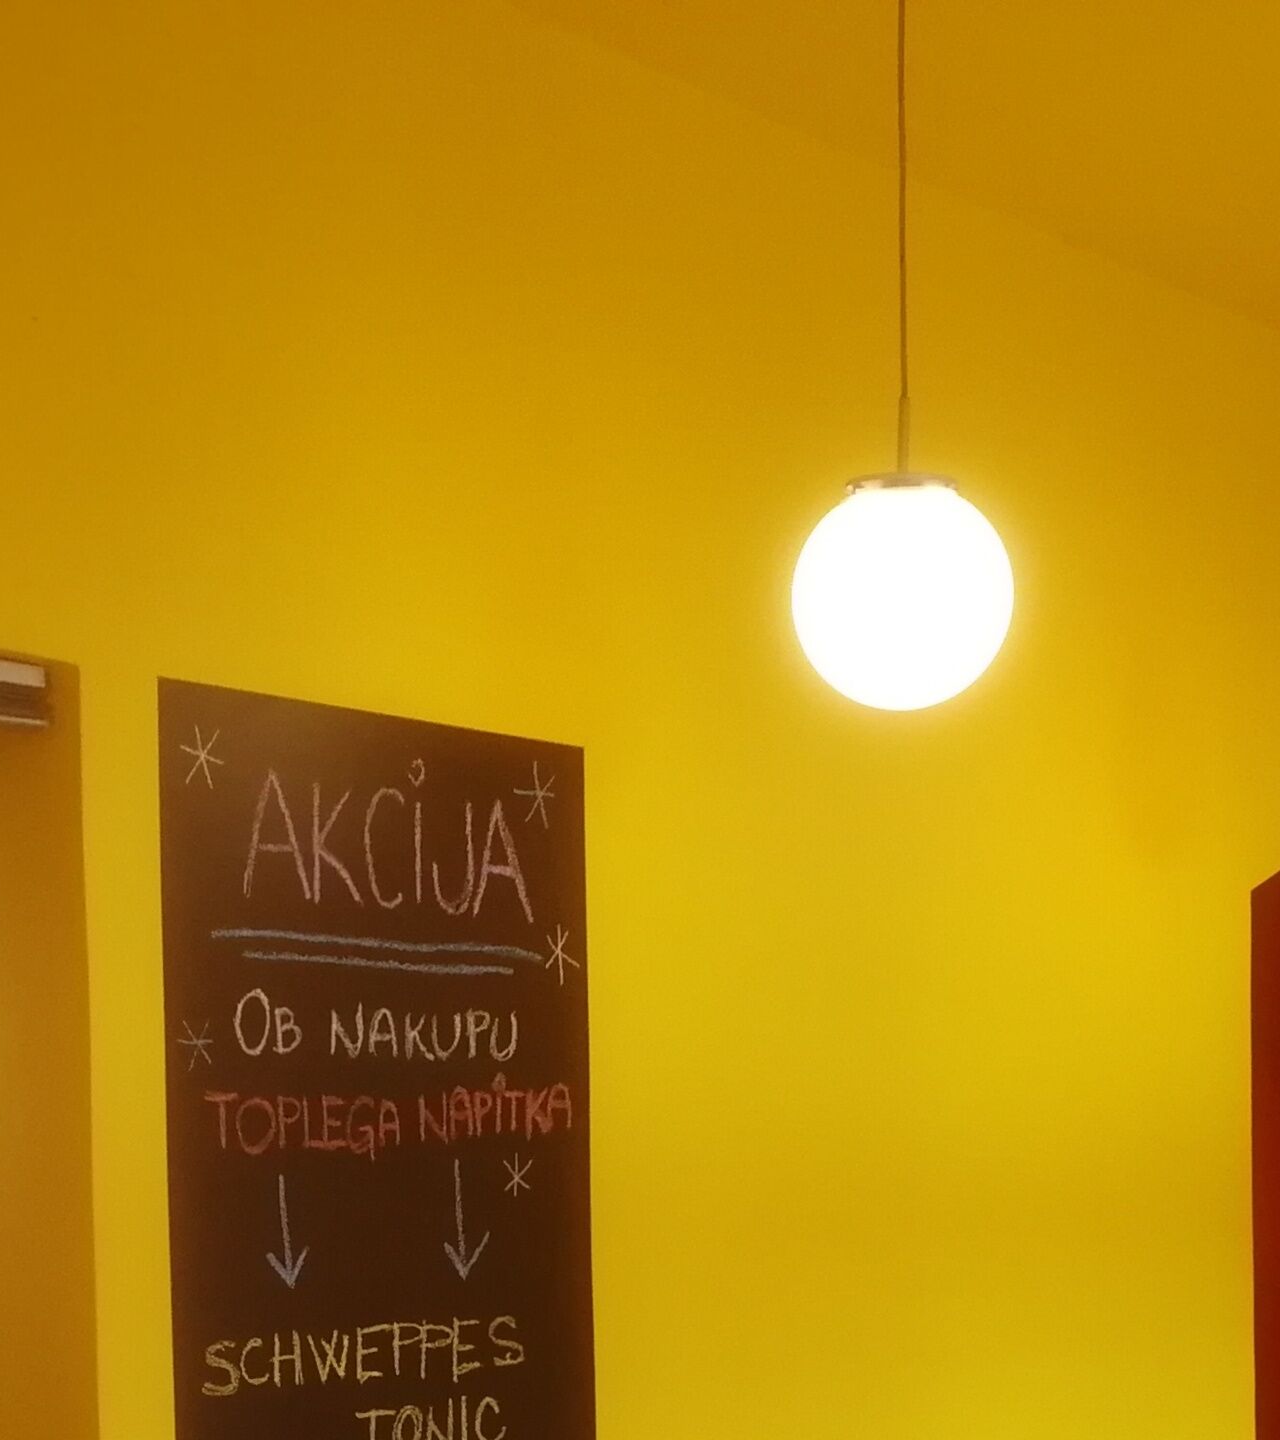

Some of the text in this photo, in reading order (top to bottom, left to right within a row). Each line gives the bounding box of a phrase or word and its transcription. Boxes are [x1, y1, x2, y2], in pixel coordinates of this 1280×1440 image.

[233, 988, 518, 1061] OB NAKUPU
[204, 1072, 573, 1160] TOPLEGA NAPITKA
[201, 1316, 525, 1397] SCHWEPPES
